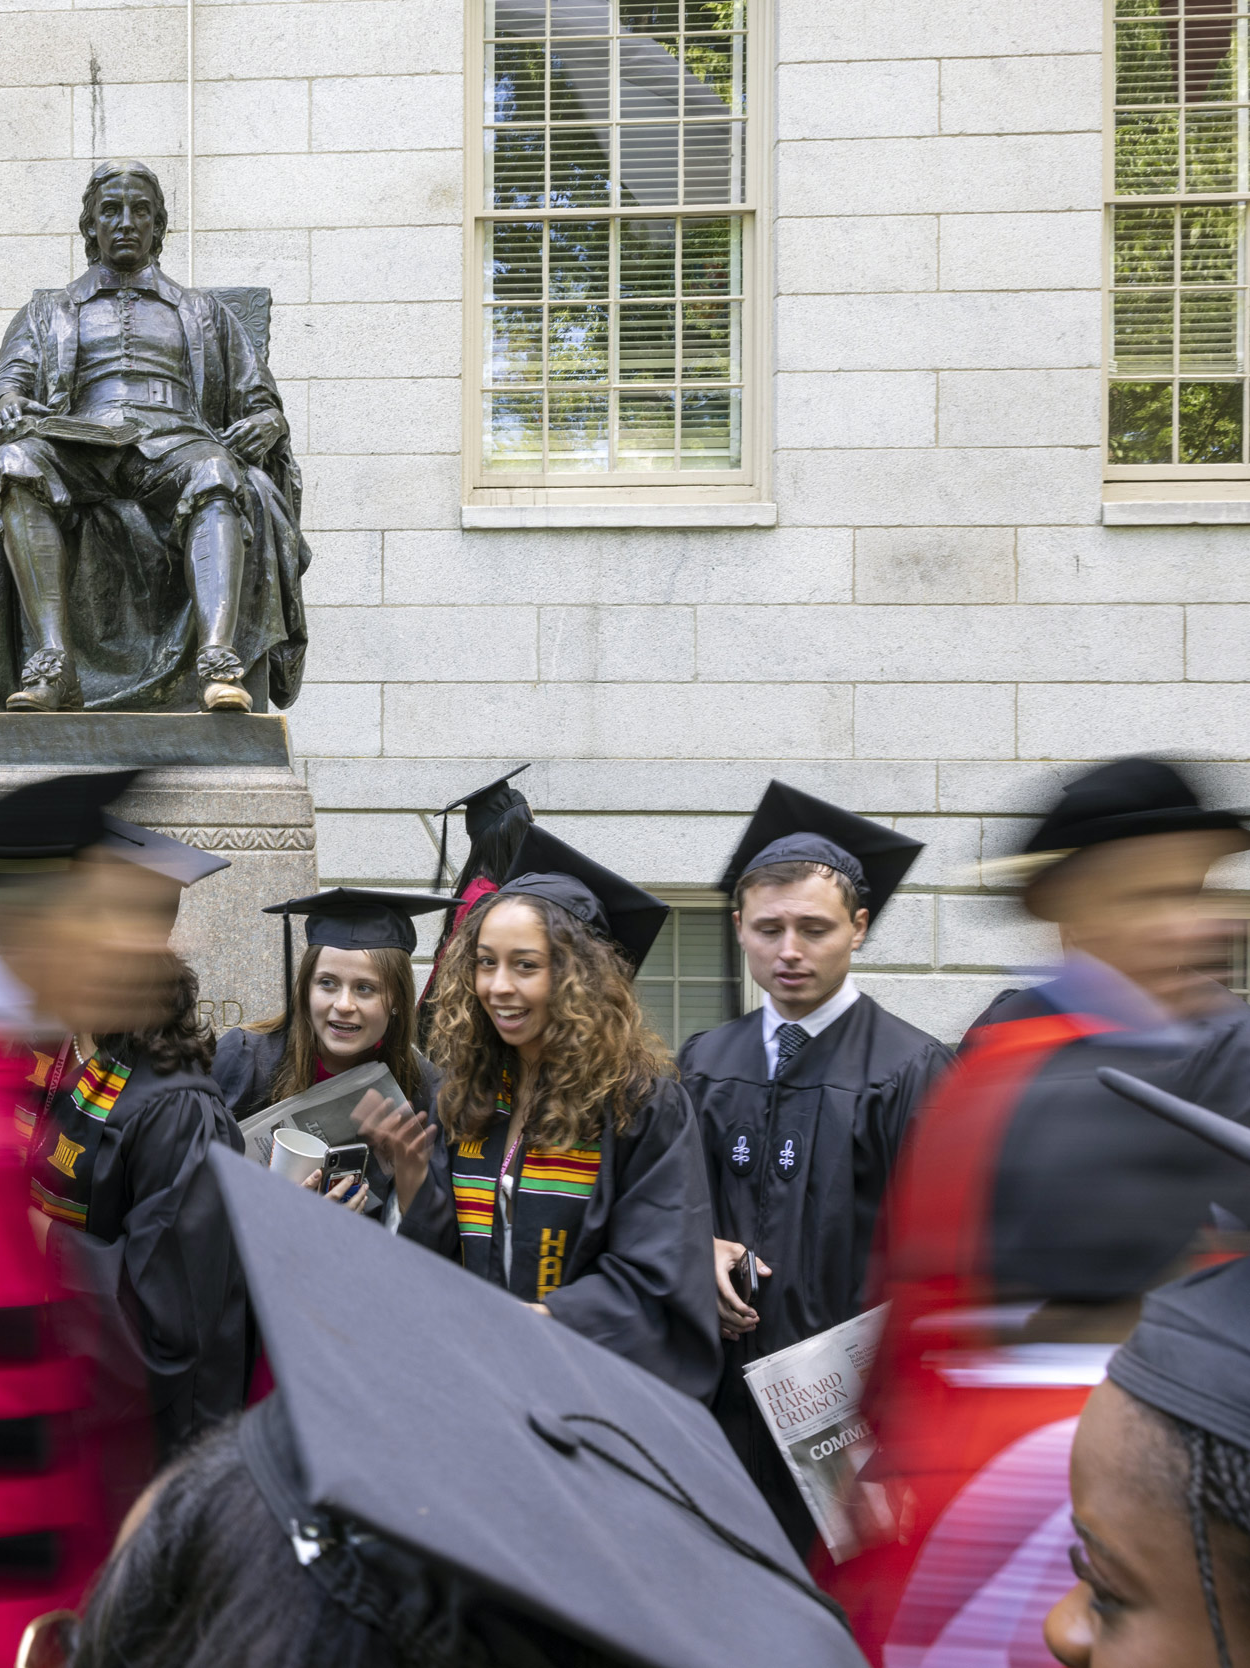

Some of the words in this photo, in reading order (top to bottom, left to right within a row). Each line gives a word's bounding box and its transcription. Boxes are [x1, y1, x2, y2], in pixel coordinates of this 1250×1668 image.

[760, 1376, 800, 1401] THE
[768, 1372, 842, 1416] HARVARD
[776, 1386, 848, 1430] CRIMSON
